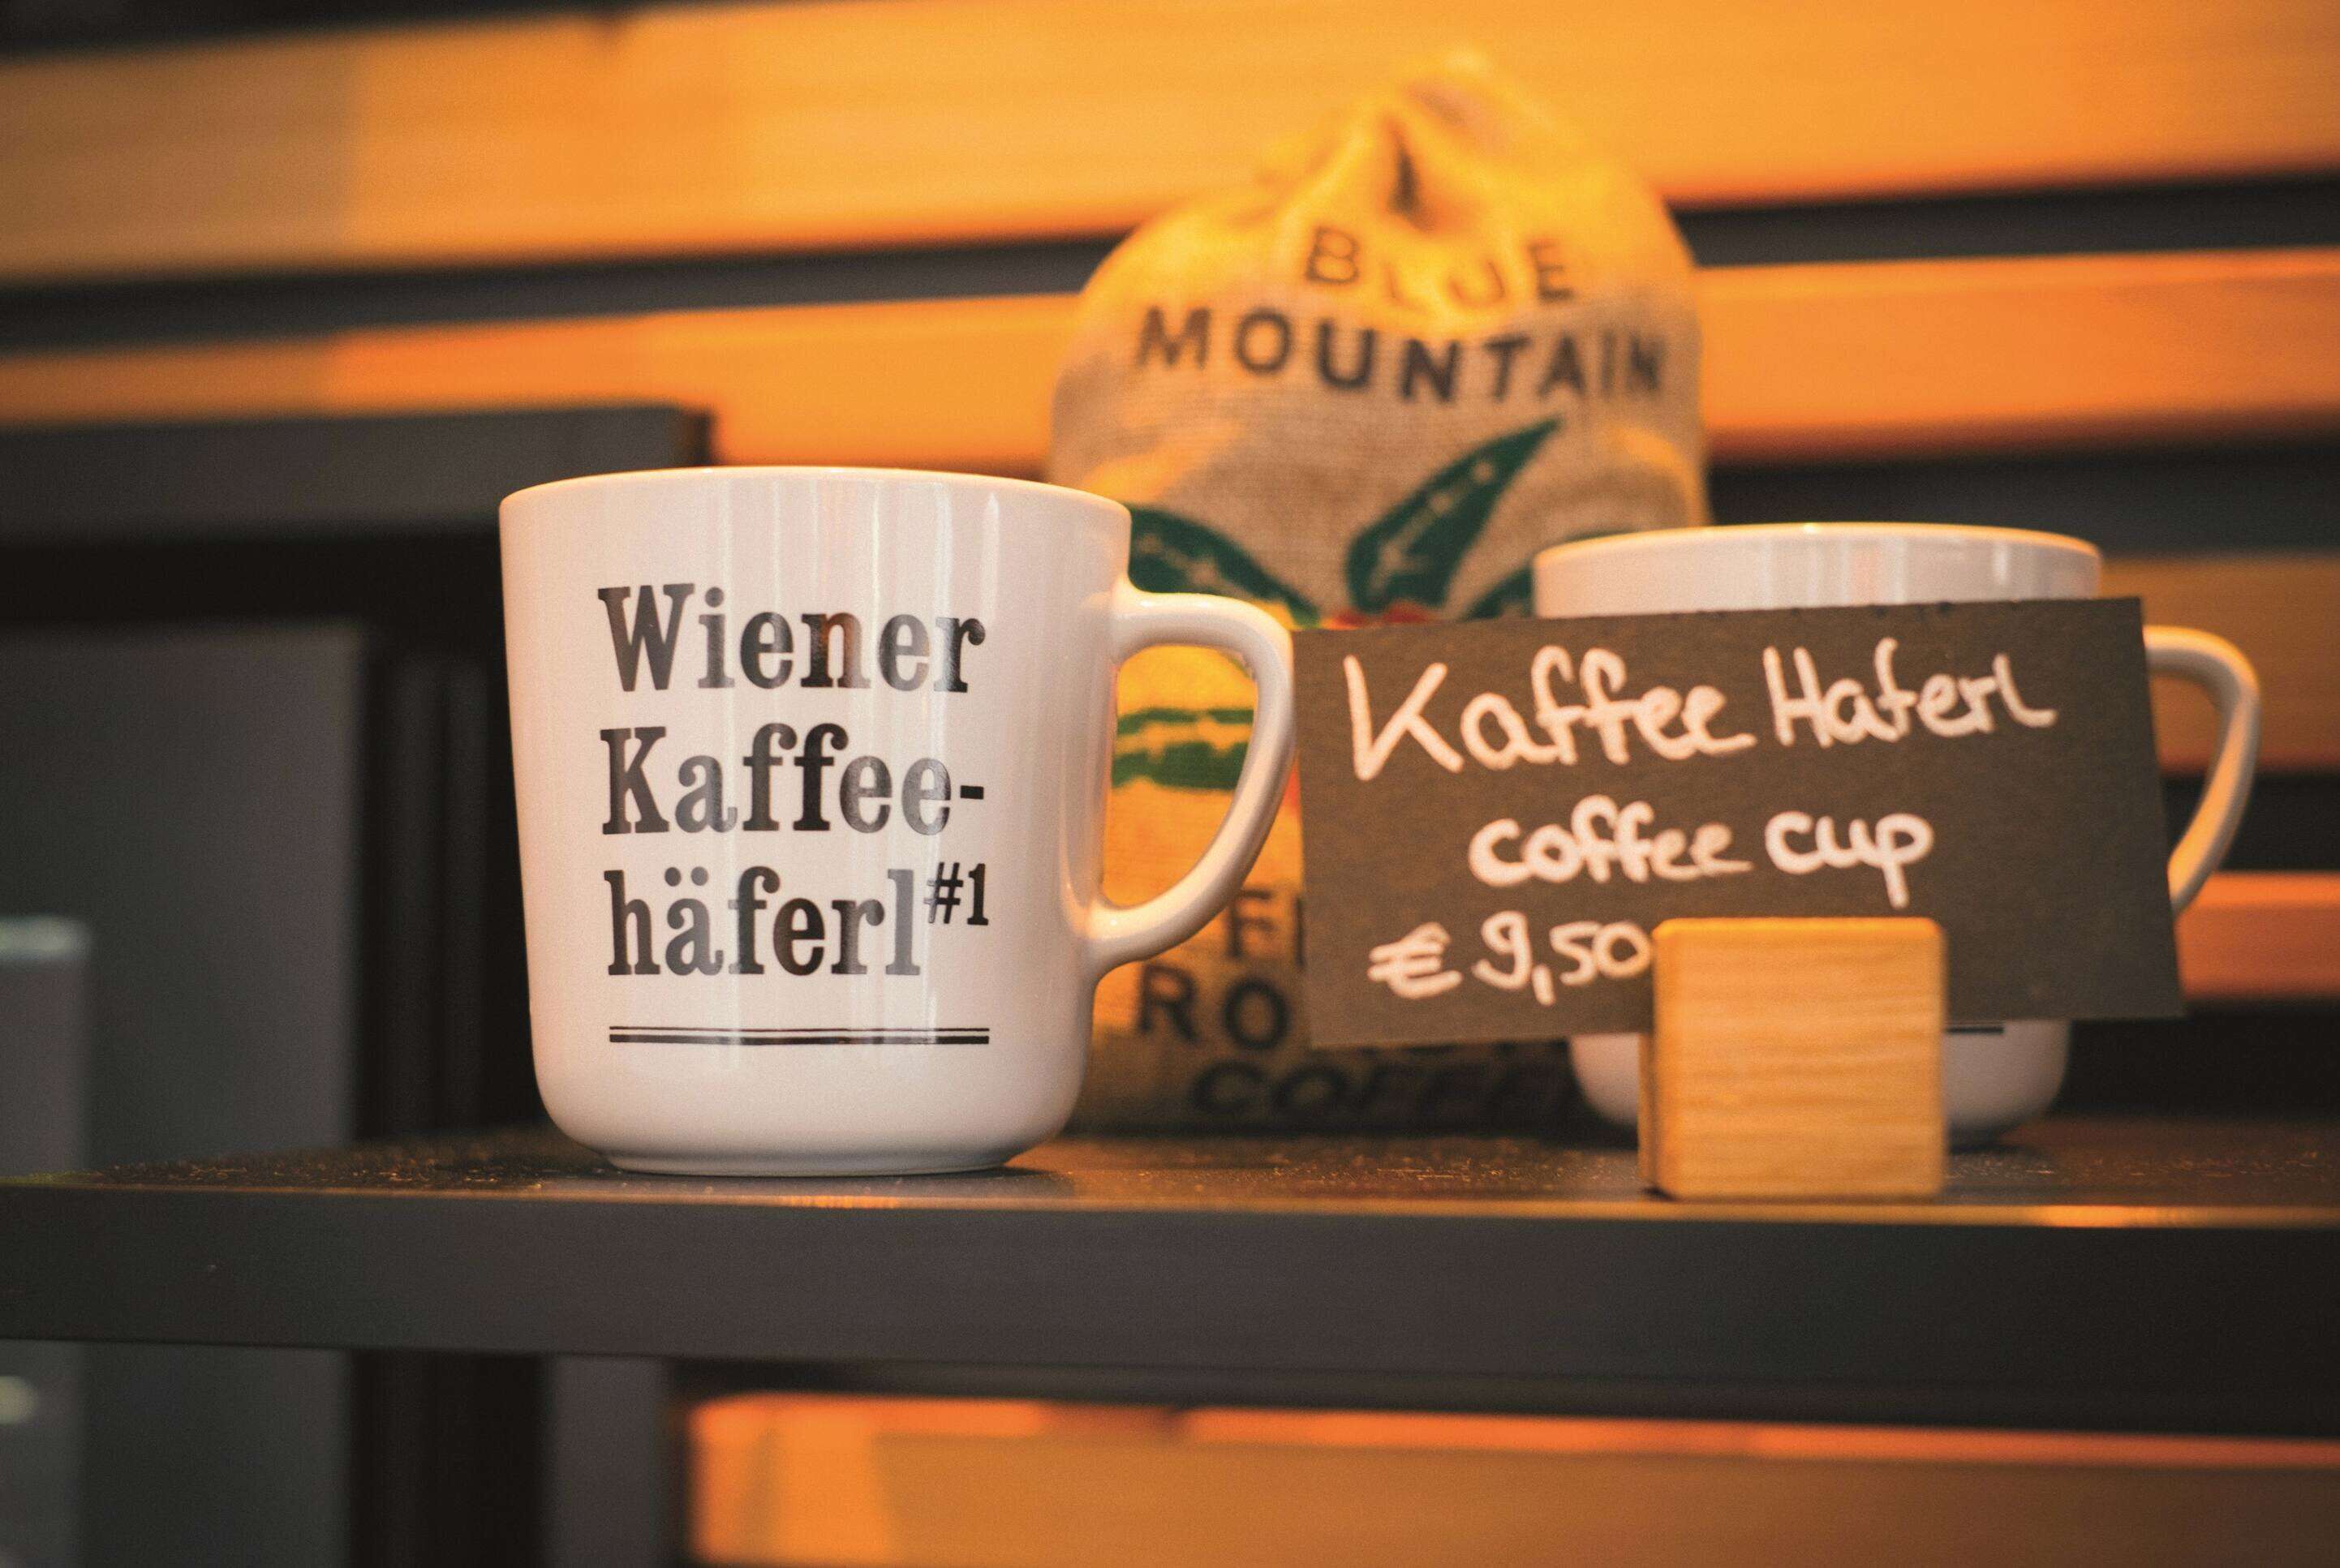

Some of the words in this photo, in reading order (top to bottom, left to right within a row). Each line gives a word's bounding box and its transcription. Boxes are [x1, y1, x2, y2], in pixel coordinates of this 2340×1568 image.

[1305, 224, 1576, 307] BLUE
[1137, 306, 1666, 404] MOUNTAIN
[597, 582, 987, 694] Wiener
[1342, 644, 1757, 781] Kaffee
[599, 722, 985, 836] Kaffee-
[1467, 793, 1754, 887] coffee
[1763, 810, 1934, 909] cup
